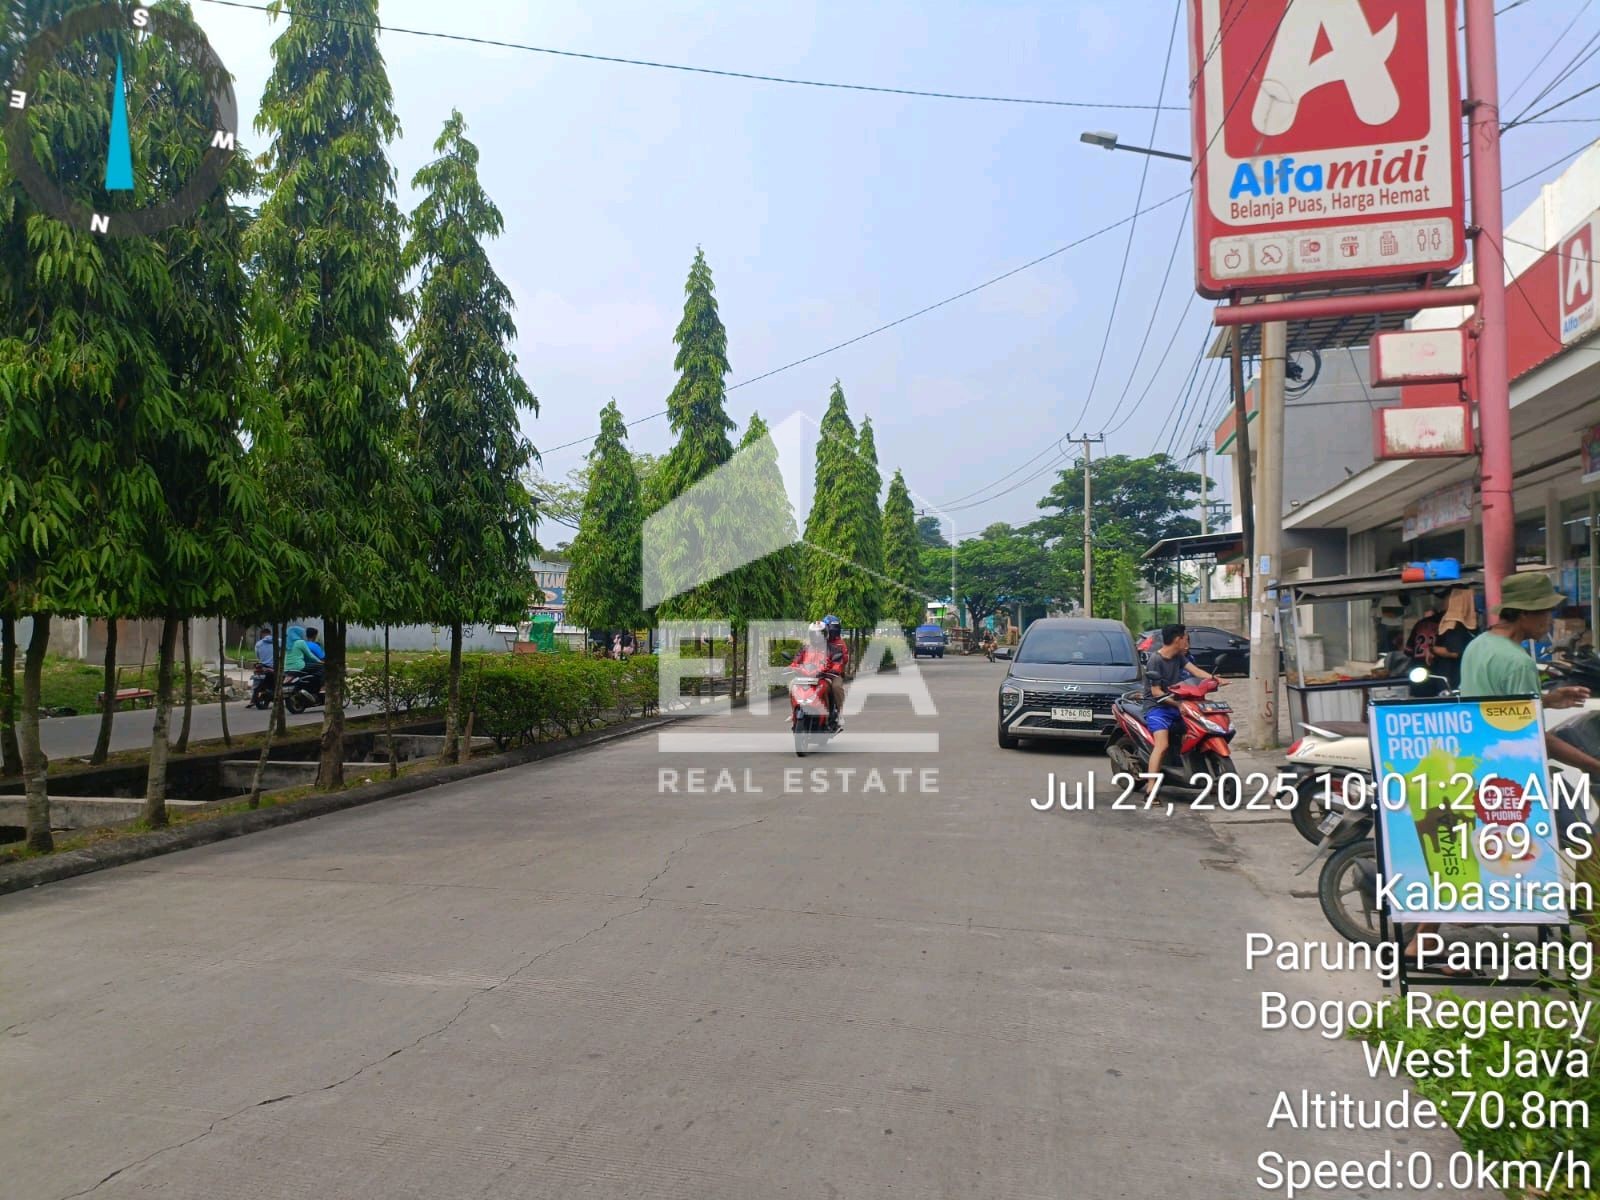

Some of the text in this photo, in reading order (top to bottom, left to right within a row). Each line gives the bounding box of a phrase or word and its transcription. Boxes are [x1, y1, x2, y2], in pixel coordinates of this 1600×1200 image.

[1229, 145, 1430, 200] Alfamidi
[1230, 185, 1430, 219] Belanja Puas, Harga Hemat
[1341, 235, 1358, 243] ATM
[1385, 710, 1473, 736] OPENING
[1486, 706, 1532, 717] SEKALA
[1388, 735, 1460, 760] PROMO
[1491, 810, 1523, 821] PUDING
